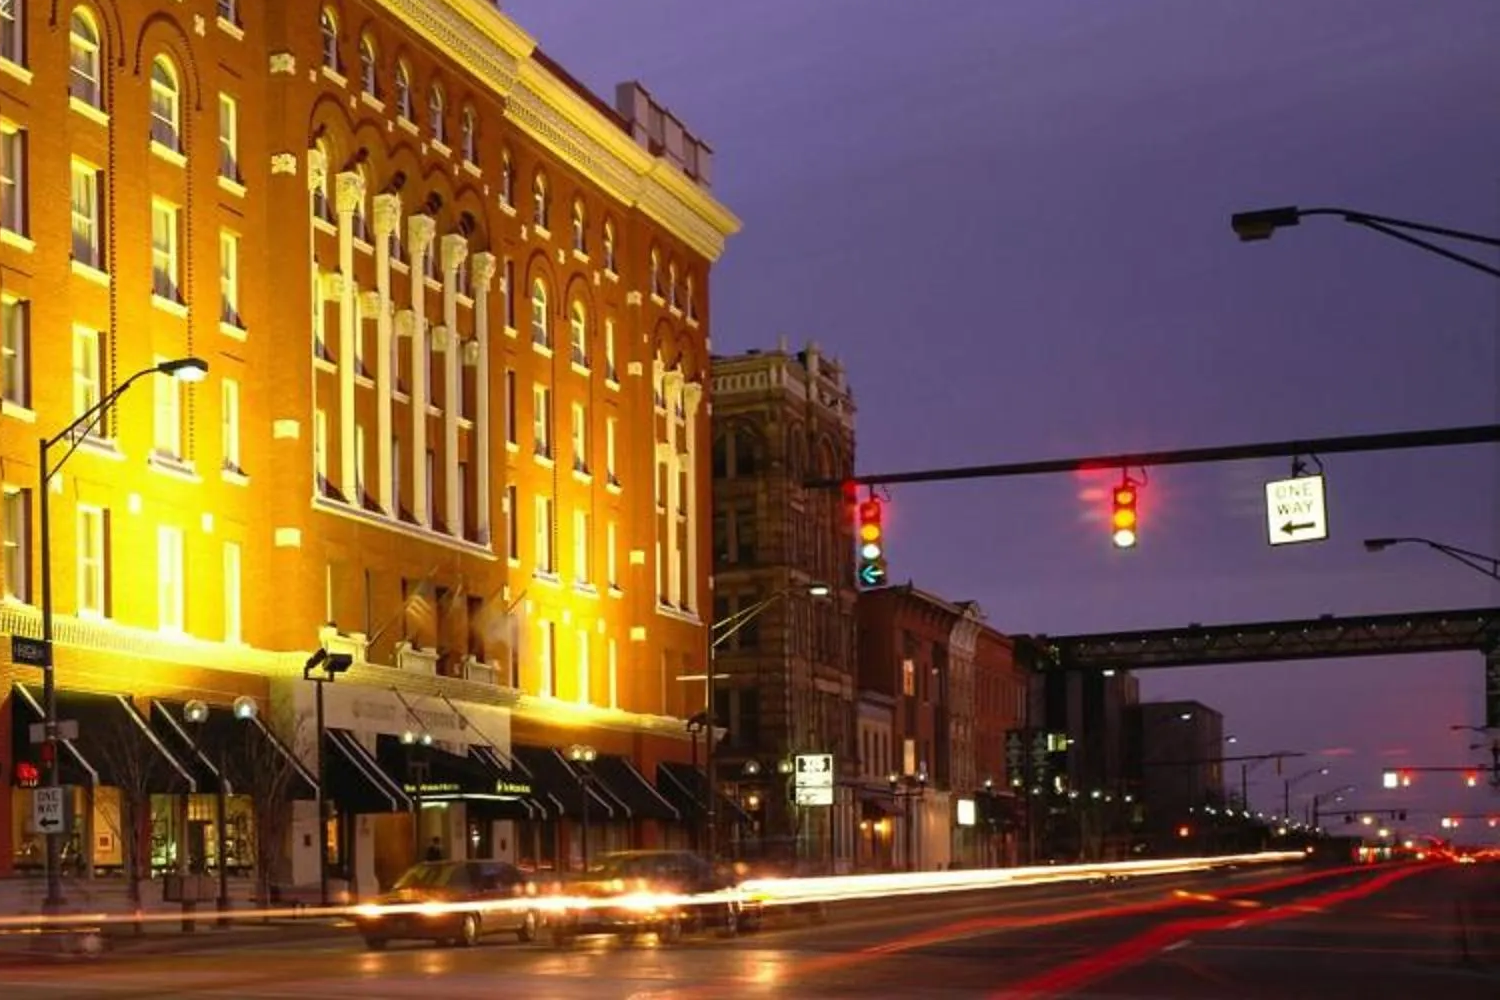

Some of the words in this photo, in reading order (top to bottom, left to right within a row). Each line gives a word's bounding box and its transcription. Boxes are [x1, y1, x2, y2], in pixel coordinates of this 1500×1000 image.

[1275, 481, 1314, 499] ONE
[1277, 500, 1314, 515] WAY
[37, 790, 60, 802] ONE
[37, 803, 59, 814] WAY
